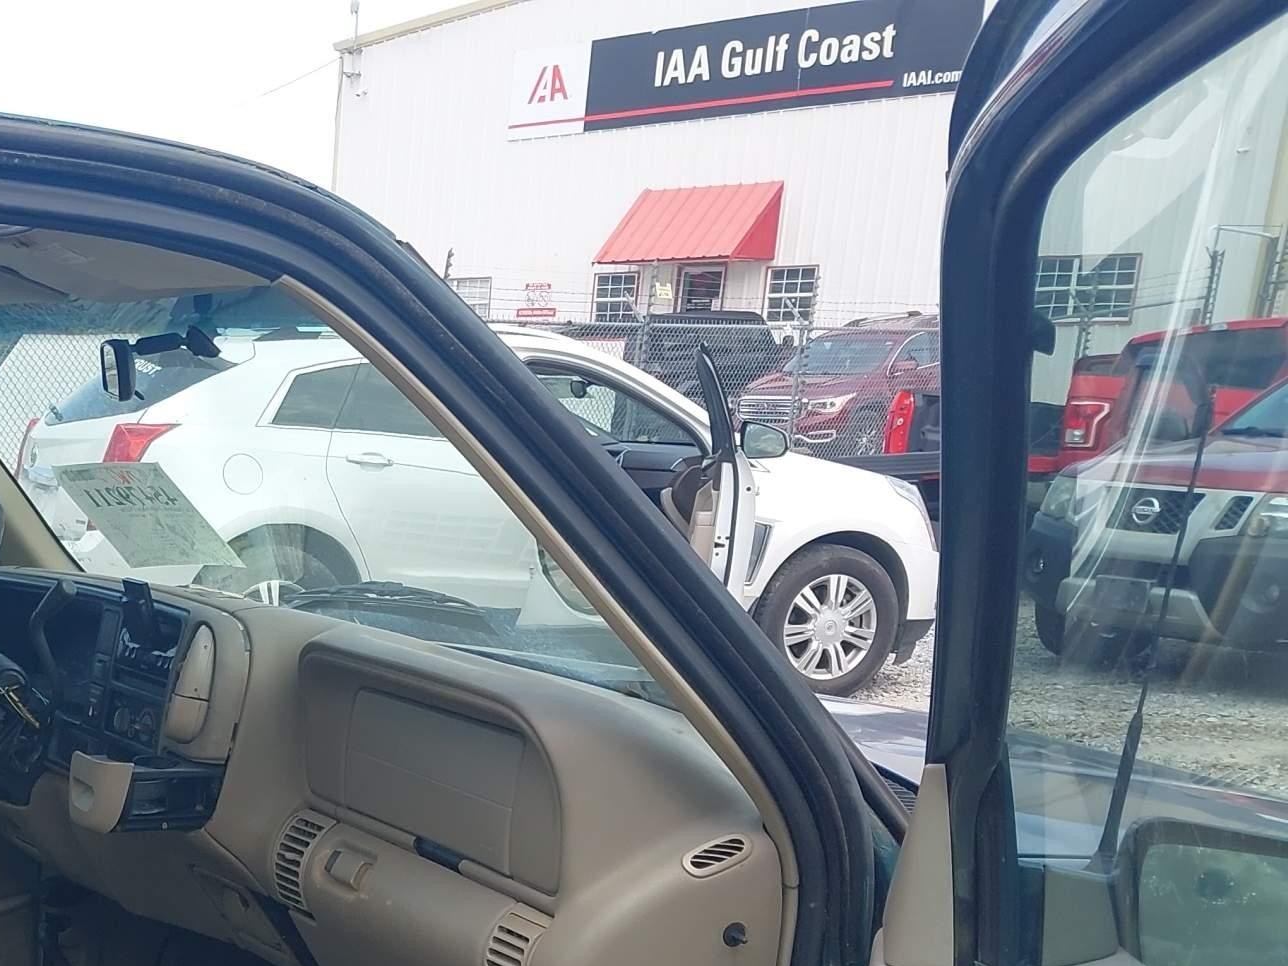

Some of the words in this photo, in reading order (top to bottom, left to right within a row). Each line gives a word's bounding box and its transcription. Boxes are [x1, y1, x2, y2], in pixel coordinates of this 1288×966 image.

[654, 45, 711, 88] IAA
[720, 33, 790, 79] Gulf
[797, 23, 897, 69] Coast
[902, 69, 963, 88] IAAI.com
